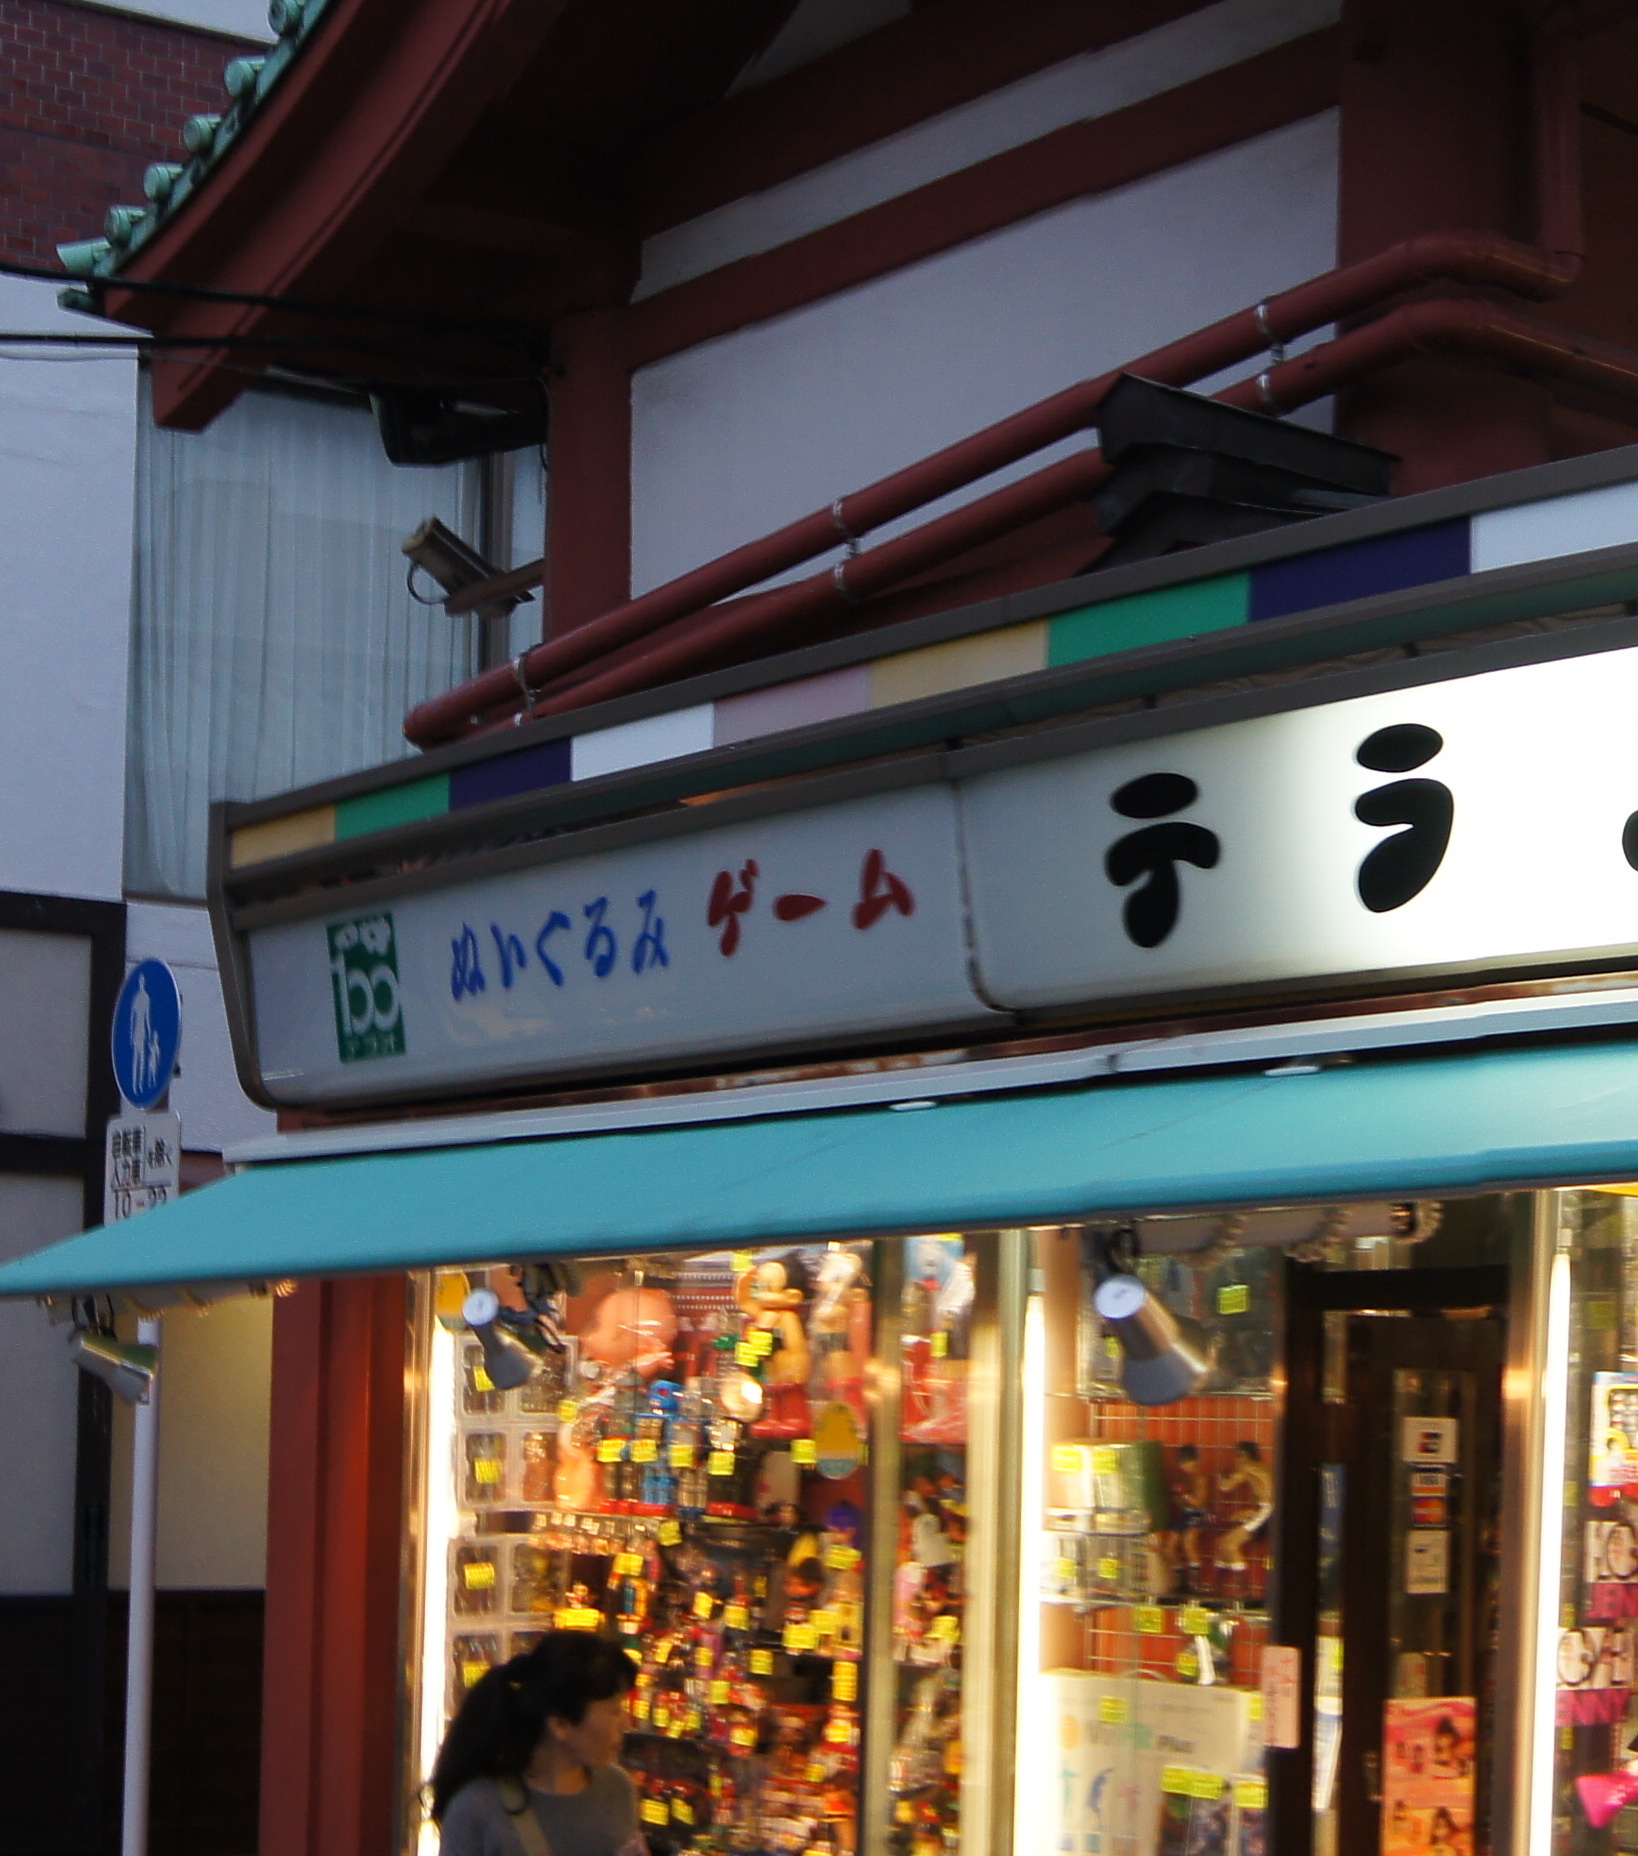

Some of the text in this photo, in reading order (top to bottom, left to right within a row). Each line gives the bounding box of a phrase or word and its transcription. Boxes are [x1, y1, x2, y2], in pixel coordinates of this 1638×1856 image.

[449, 847, 915, 1001] ぬいぐるみ ゲーム
